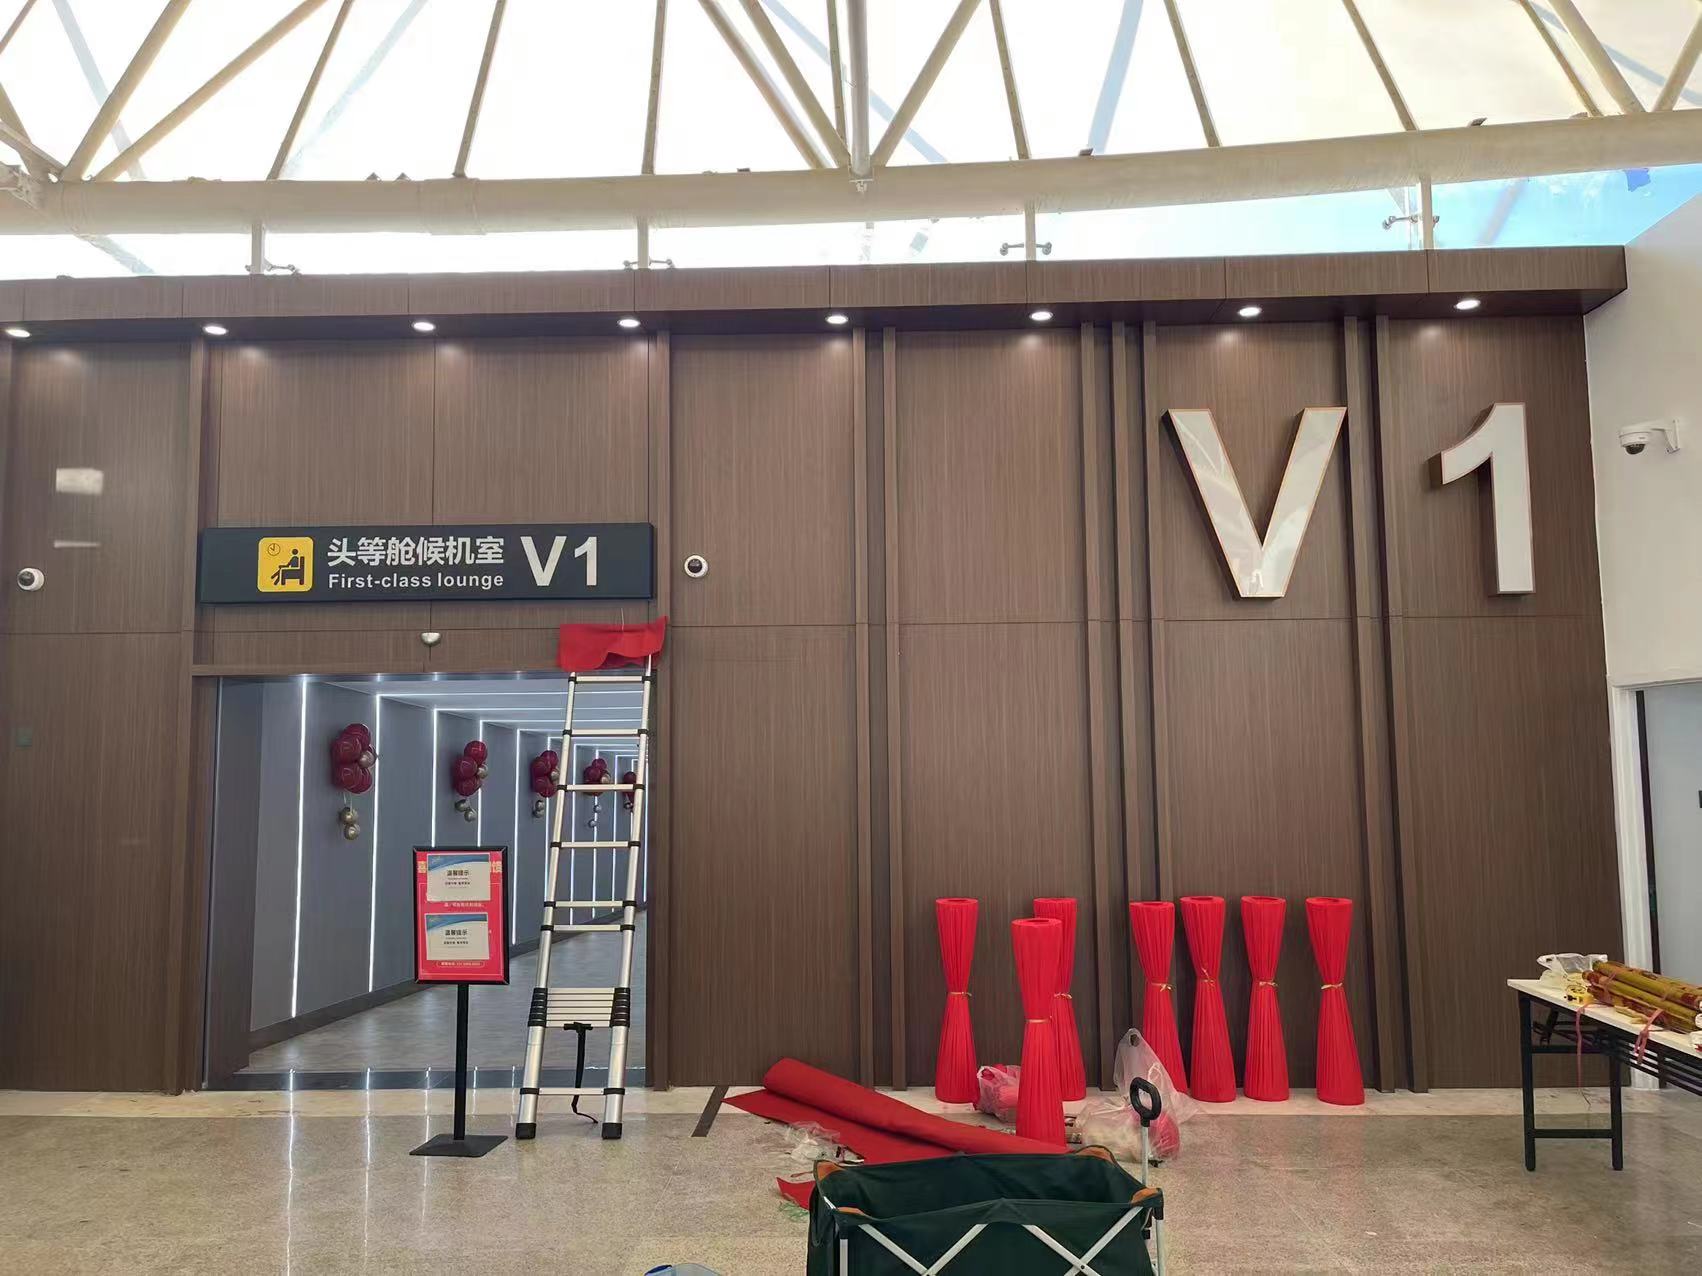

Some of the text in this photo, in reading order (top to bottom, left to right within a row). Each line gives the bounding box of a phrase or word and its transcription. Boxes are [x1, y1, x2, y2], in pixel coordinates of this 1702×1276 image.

[1166, 402, 1535, 598] V1
[327, 536, 505, 567] 头等舱候机室
[520, 535, 598, 587] V1
[328, 572, 504, 590] First-class lounge
